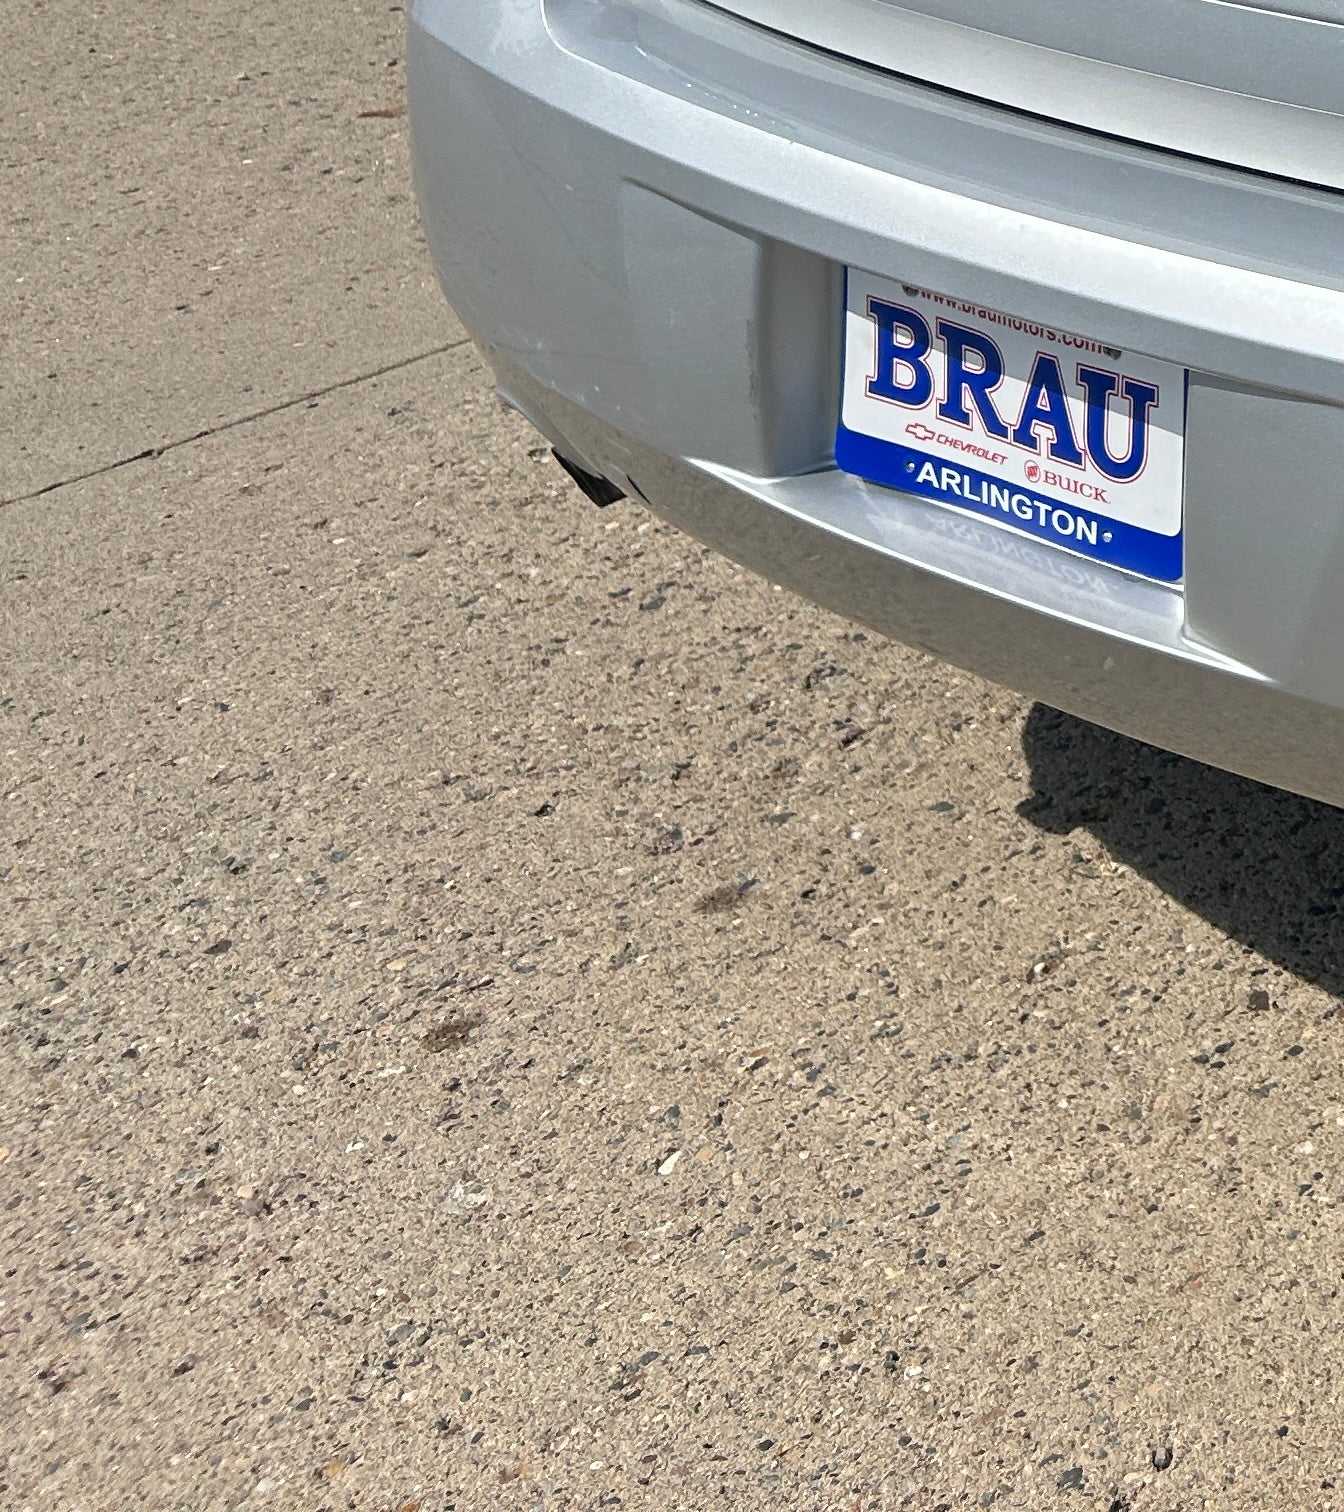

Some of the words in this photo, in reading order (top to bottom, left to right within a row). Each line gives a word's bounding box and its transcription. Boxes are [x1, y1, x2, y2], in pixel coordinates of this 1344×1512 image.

[865, 294, 1159, 484] BRAU
[936, 433, 1008, 466] CHEVROLET
[916, 461, 1098, 546] ARLINGTON
[1043, 468, 1111, 504] BUICK
